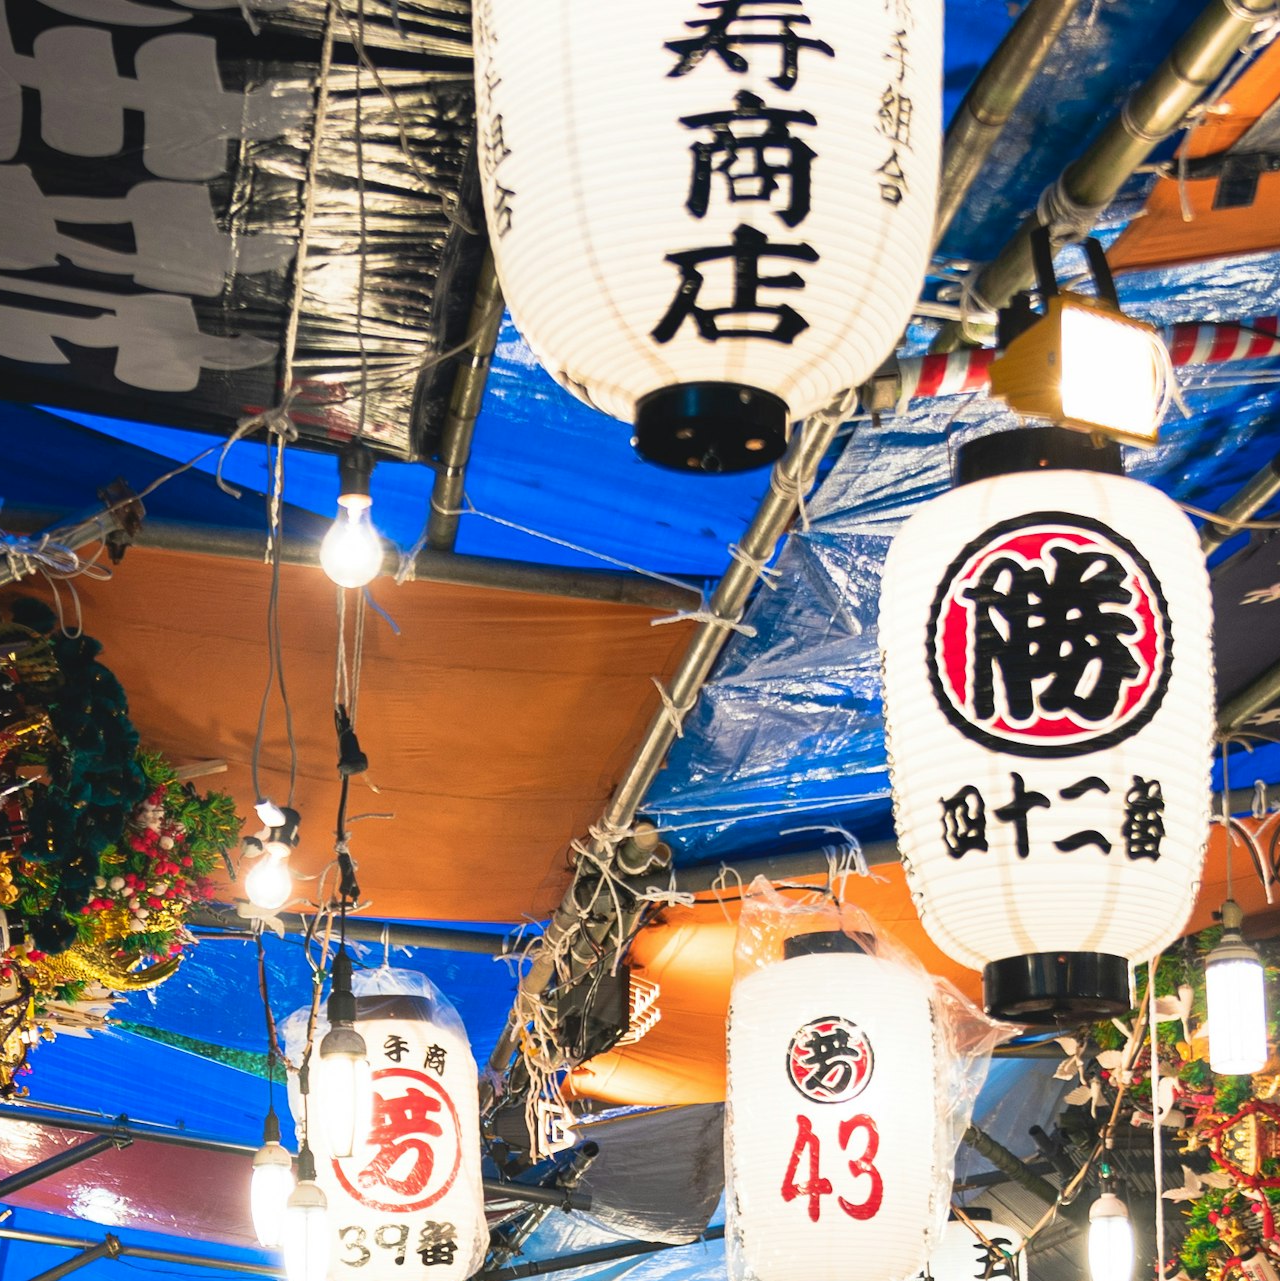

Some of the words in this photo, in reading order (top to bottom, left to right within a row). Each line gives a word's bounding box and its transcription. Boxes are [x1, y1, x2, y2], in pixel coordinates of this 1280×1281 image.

[962, 547, 1141, 722] 勝
[940, 772, 1165, 861] 四十二番
[781, 1114, 883, 1222] 43
[339, 1220, 458, 1267] 39番
